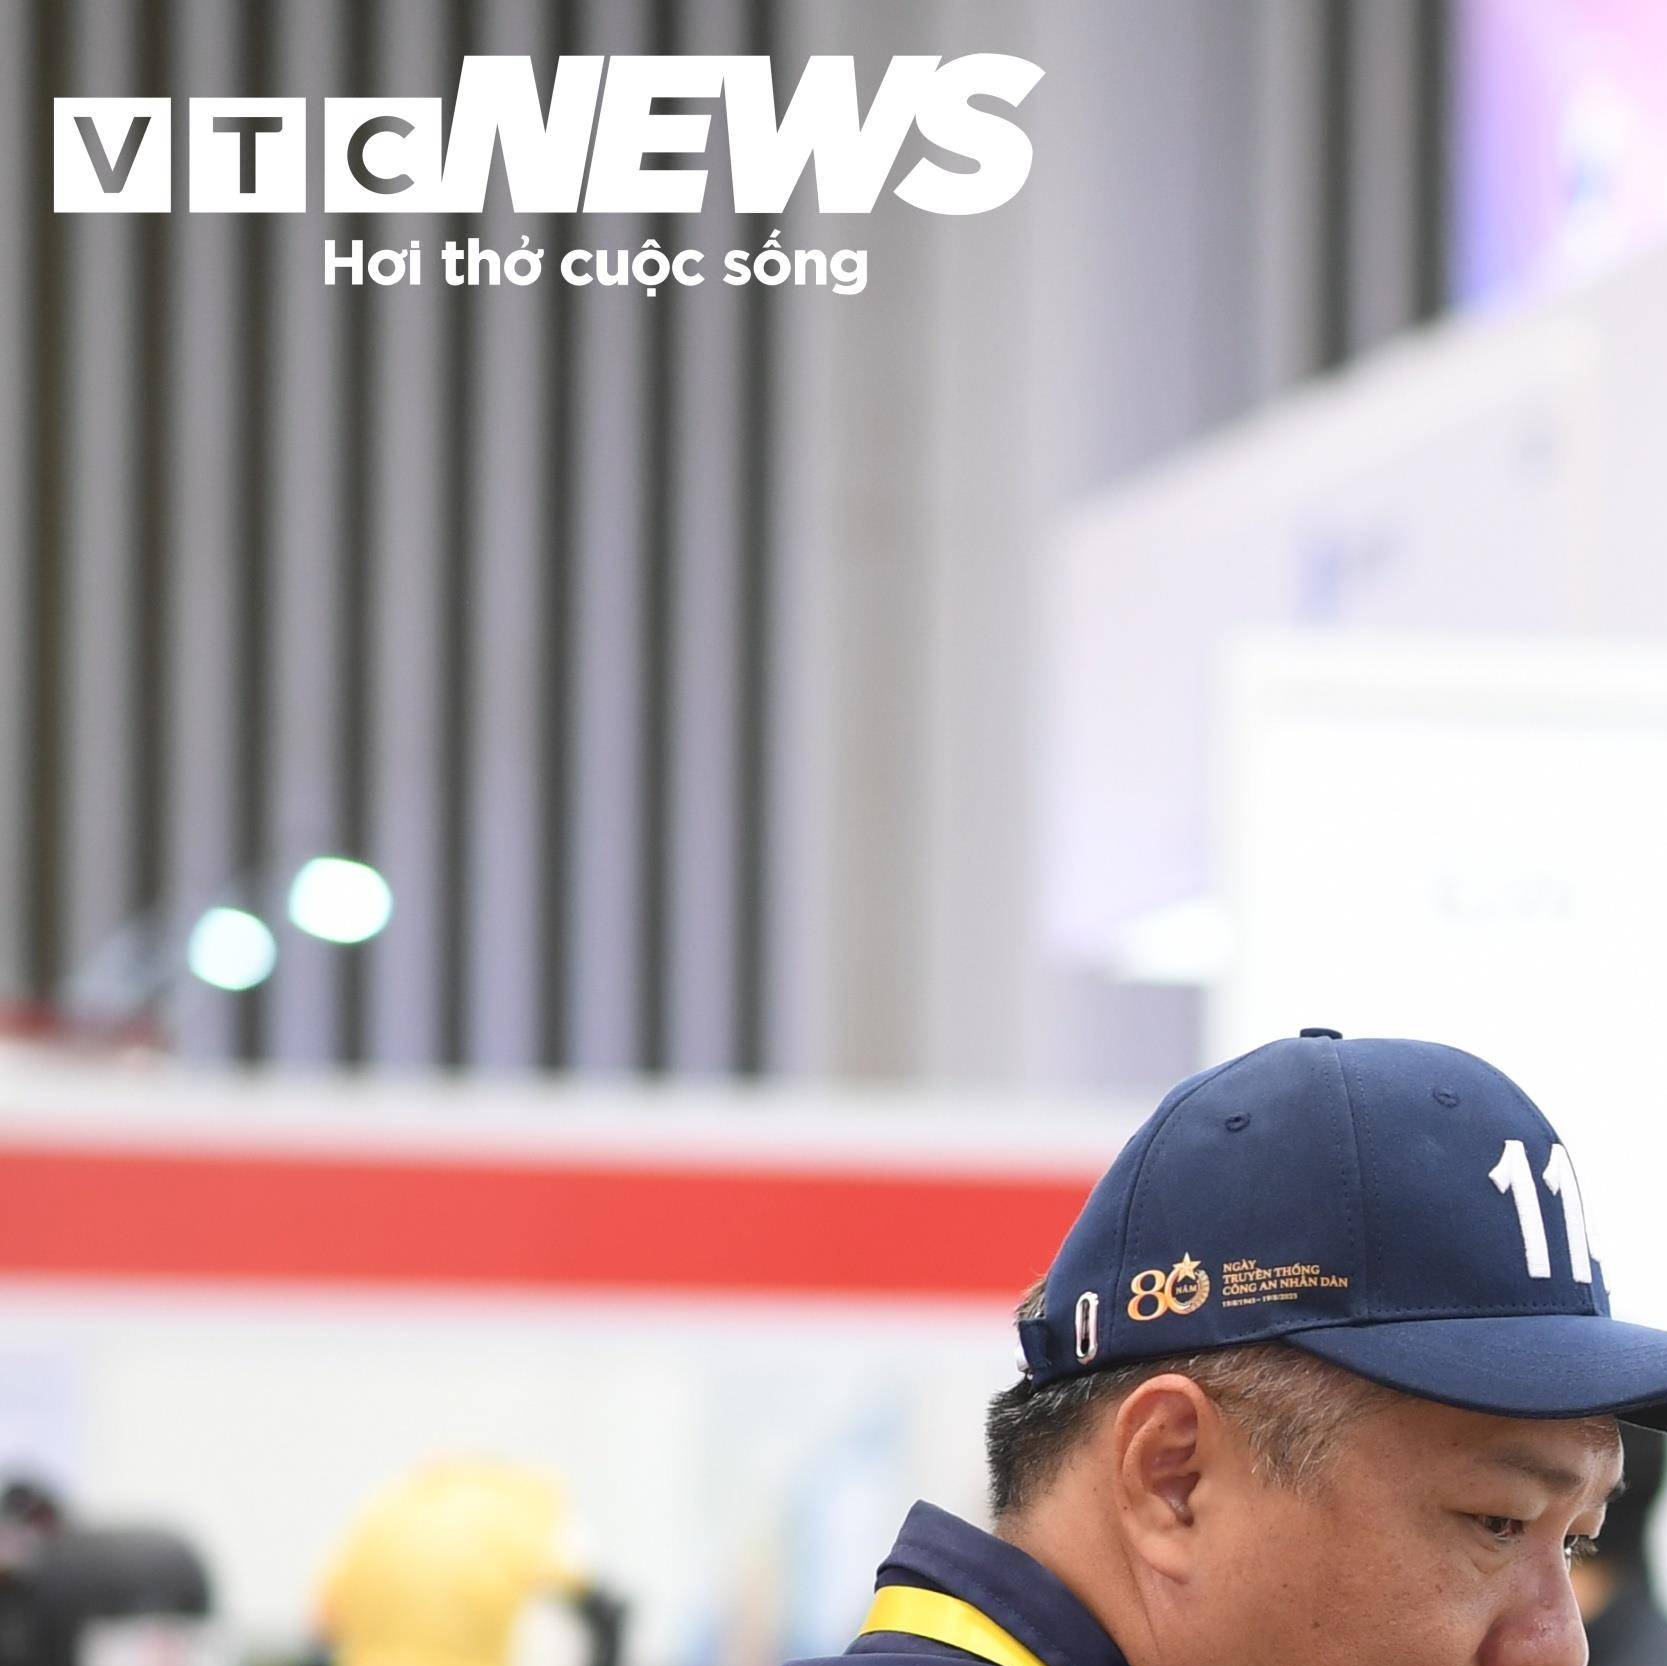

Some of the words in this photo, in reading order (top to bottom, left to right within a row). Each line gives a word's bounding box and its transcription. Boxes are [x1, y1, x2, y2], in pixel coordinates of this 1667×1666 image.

[1222, 1258, 1257, 1273] NGÀY
[1222, 1268, 1272, 1285] TRUYỀN
[1274, 1263, 1320, 1278] THỐNG
[1222, 1281, 1257, 1296] CÔNG
[1259, 1279, 1277, 1291] AN
[1280, 1275, 1318, 1289] NHÂN
[1320, 1274, 1348, 1288] DÂN
